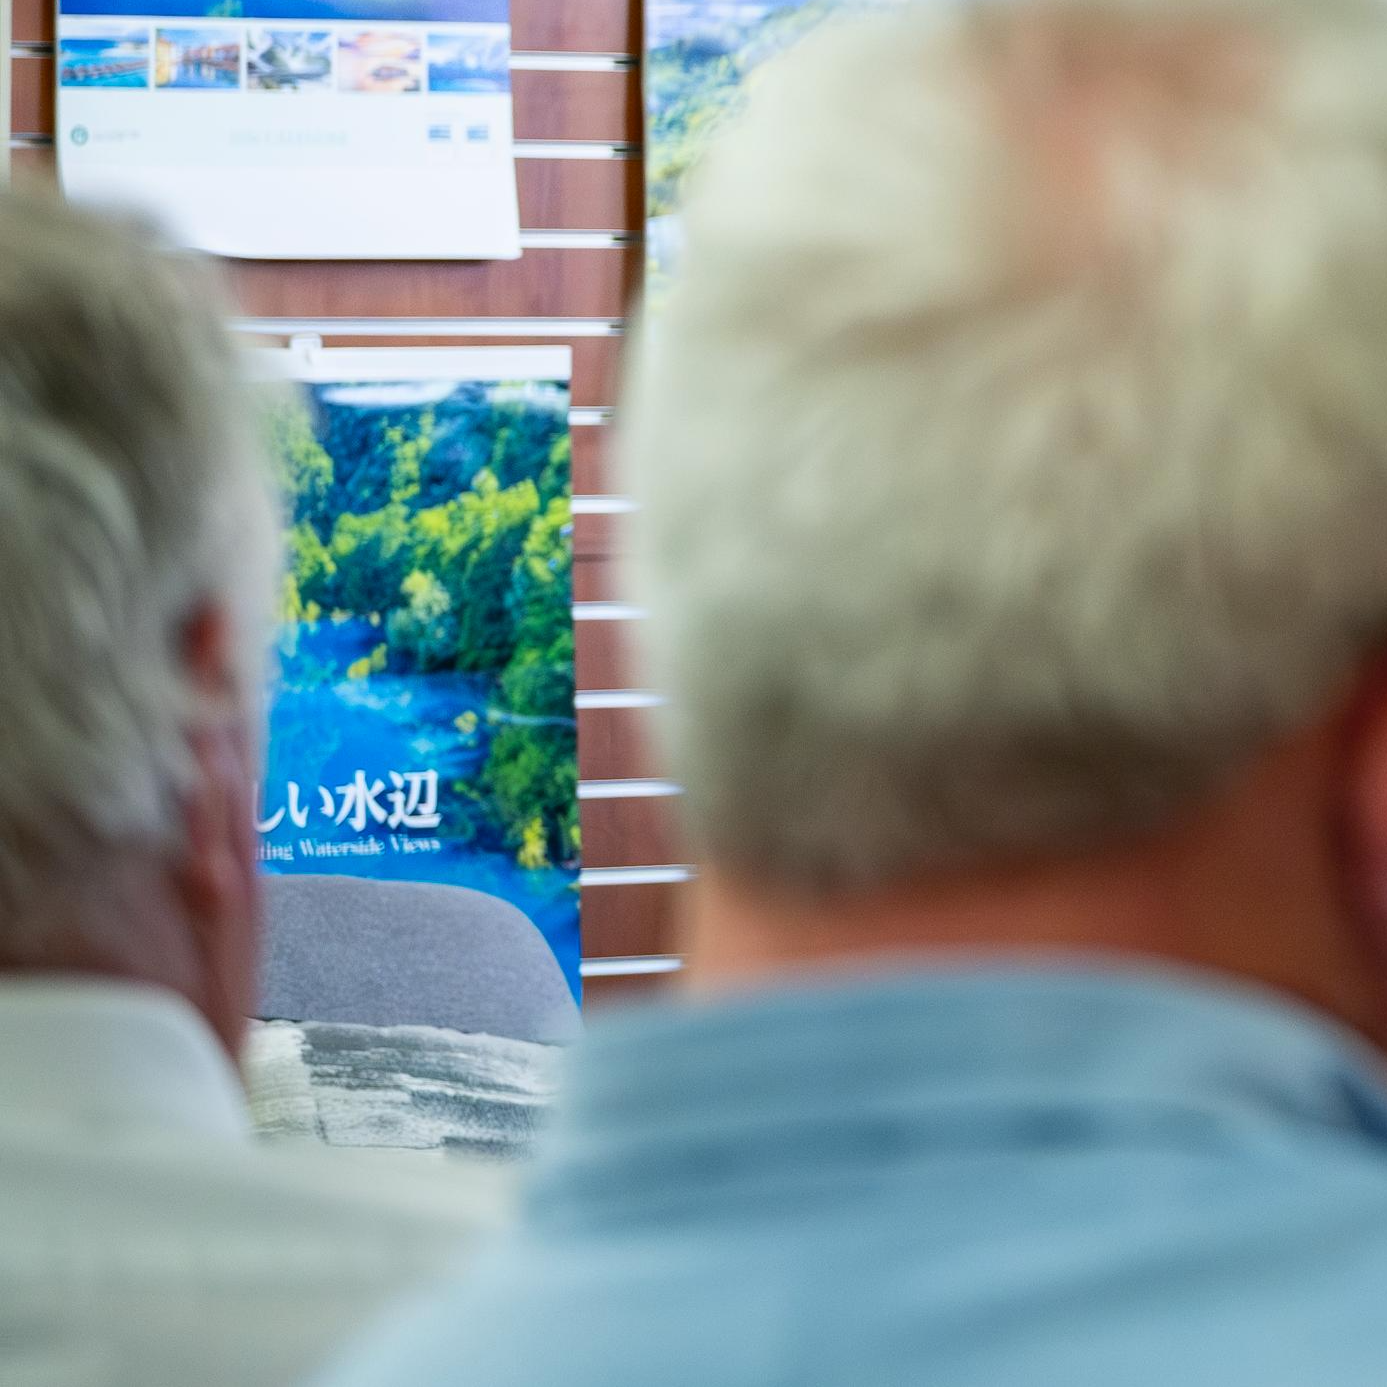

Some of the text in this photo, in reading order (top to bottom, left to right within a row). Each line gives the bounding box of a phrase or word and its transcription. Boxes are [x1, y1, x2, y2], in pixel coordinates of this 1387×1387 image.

[253, 769, 442, 833] しい水辺
[300, 836, 386, 858] Waterside
[390, 834, 441, 854] Views
